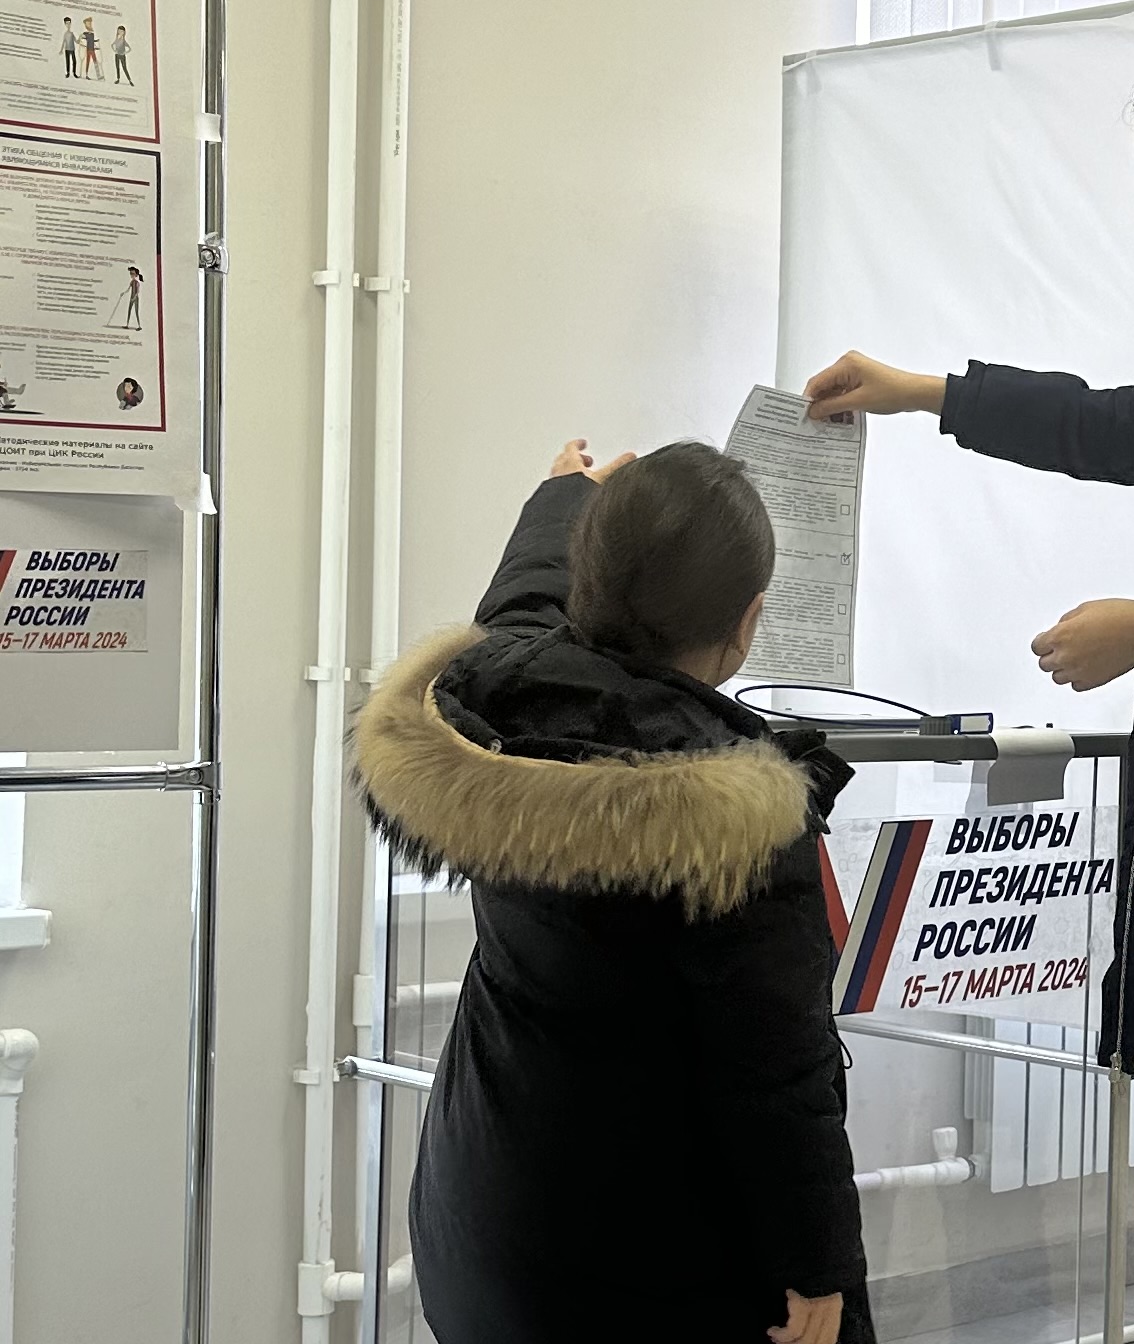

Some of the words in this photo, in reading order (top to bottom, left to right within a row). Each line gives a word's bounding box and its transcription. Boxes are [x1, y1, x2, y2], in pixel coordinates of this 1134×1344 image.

[0, 437, 60, 447] етодические
[62, 440, 112, 449] материалы
[128, 442, 154, 451] сайте
[71, 450, 104, 459] России
[25, 551, 120, 572] ВЫБОРЫ
[15, 578, 146, 602] ПРЕЗИДЕНТА
[4, 606, 91, 626] РОССИИ
[39, 632, 90, 649] МАРТА
[92, 632, 128, 649] 2024
[945, 811, 1080, 855] ВЫБОРЫ
[929, 859, 1115, 908] ПРЕЗИДЕНТА
[912, 914, 1038, 962] РОССИИ
[962, 963, 1035, 1001] МАРТА
[1037, 957, 1089, 993] 2024
